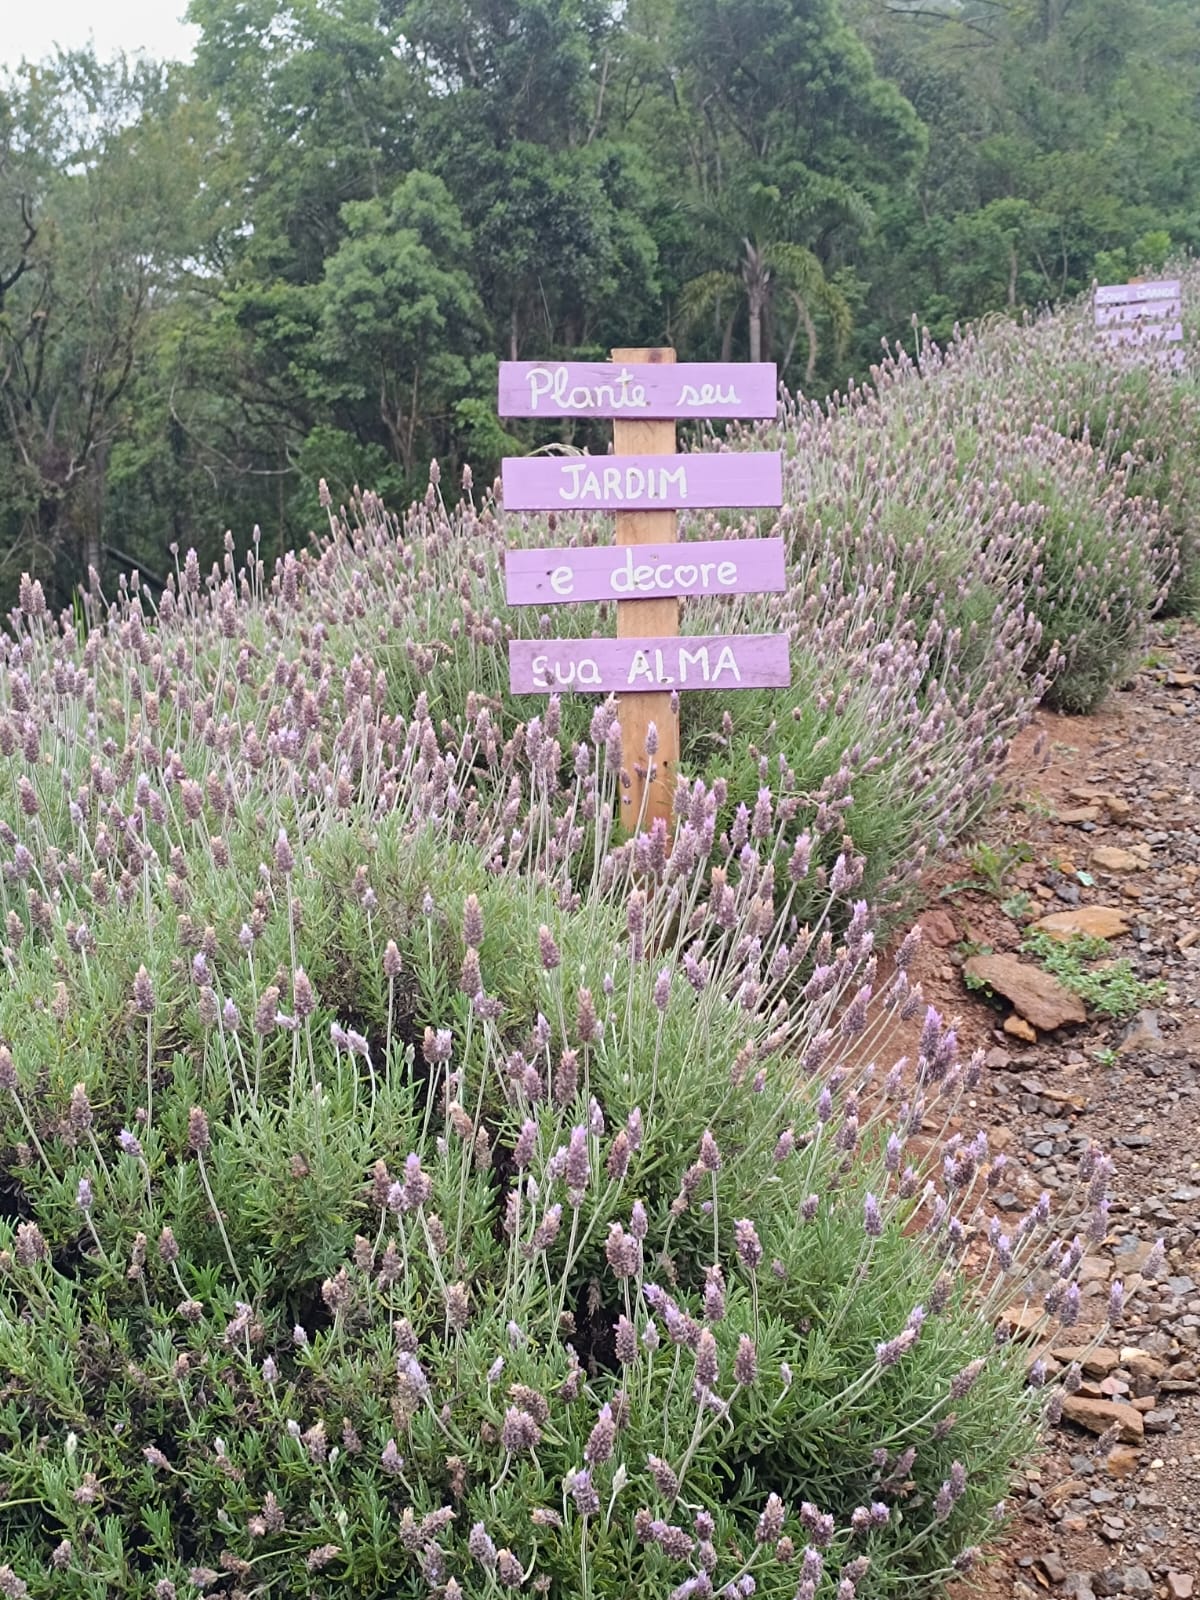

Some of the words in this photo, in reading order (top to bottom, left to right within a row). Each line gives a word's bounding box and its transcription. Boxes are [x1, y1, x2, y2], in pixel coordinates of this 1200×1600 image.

[525, 366, 648, 409] Plante
[676, 383, 742, 406] seu
[559, 463, 688, 500] JARDIM
[550, 565, 574, 595] e
[610, 547, 738, 592] decore
[627, 645, 741, 684] ALMA
